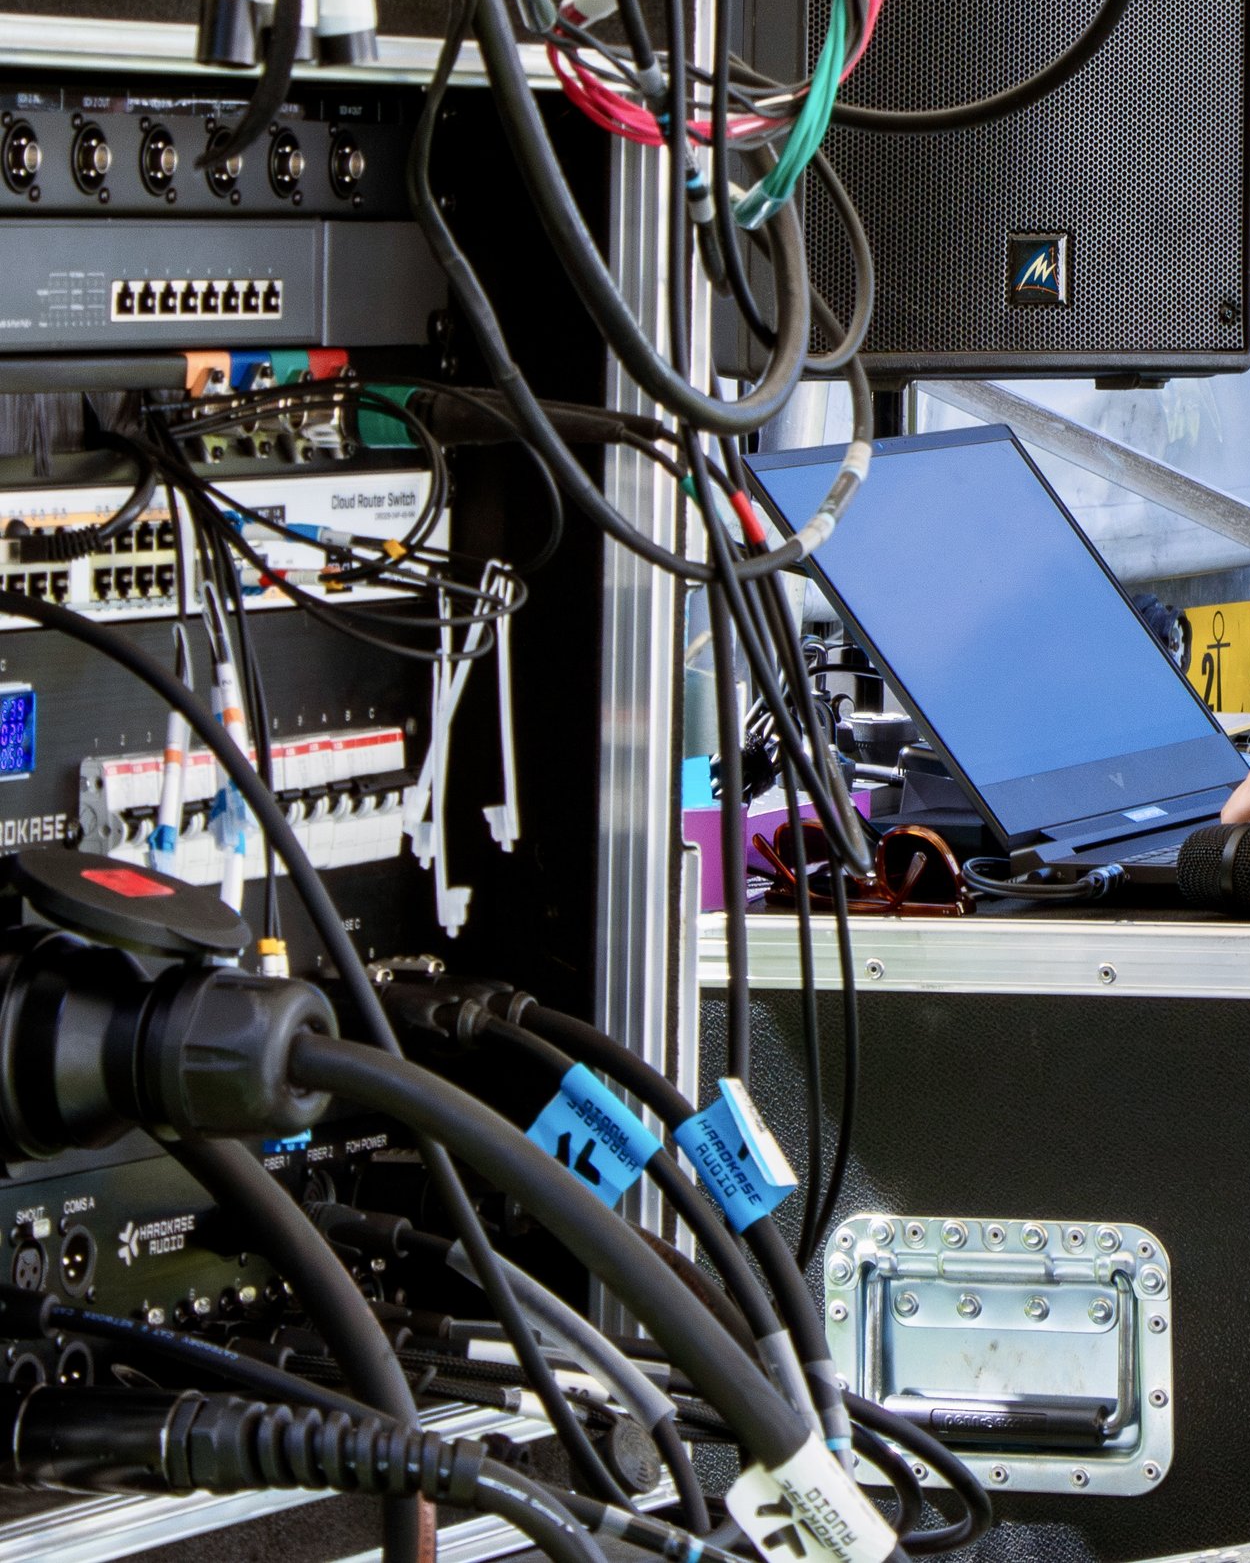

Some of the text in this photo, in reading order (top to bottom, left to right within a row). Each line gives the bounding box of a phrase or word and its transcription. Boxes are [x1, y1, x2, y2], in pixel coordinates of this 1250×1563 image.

[331, 491, 415, 510] Cloud Router Switch
[583, 1098, 631, 1148] AUDIO
[345, 1134, 387, 1154] FOH POWER
[566, 1100, 640, 1174] HARDKASE
[264, 1155, 285, 1170] FIBER
[307, 1146, 334, 1162] FIBER 2
[697, 1118, 762, 1206] HARDKASE
[695, 1144, 739, 1198] AUDIO
[63, 1197, 95, 1215] COMS A
[139, 1214, 195, 1240] HARDKASE
[149, 1234, 185, 1255] AUDIO
[82, 1310, 134, 1330] NETWORK
[804, 1487, 857, 1547] AUDIO
